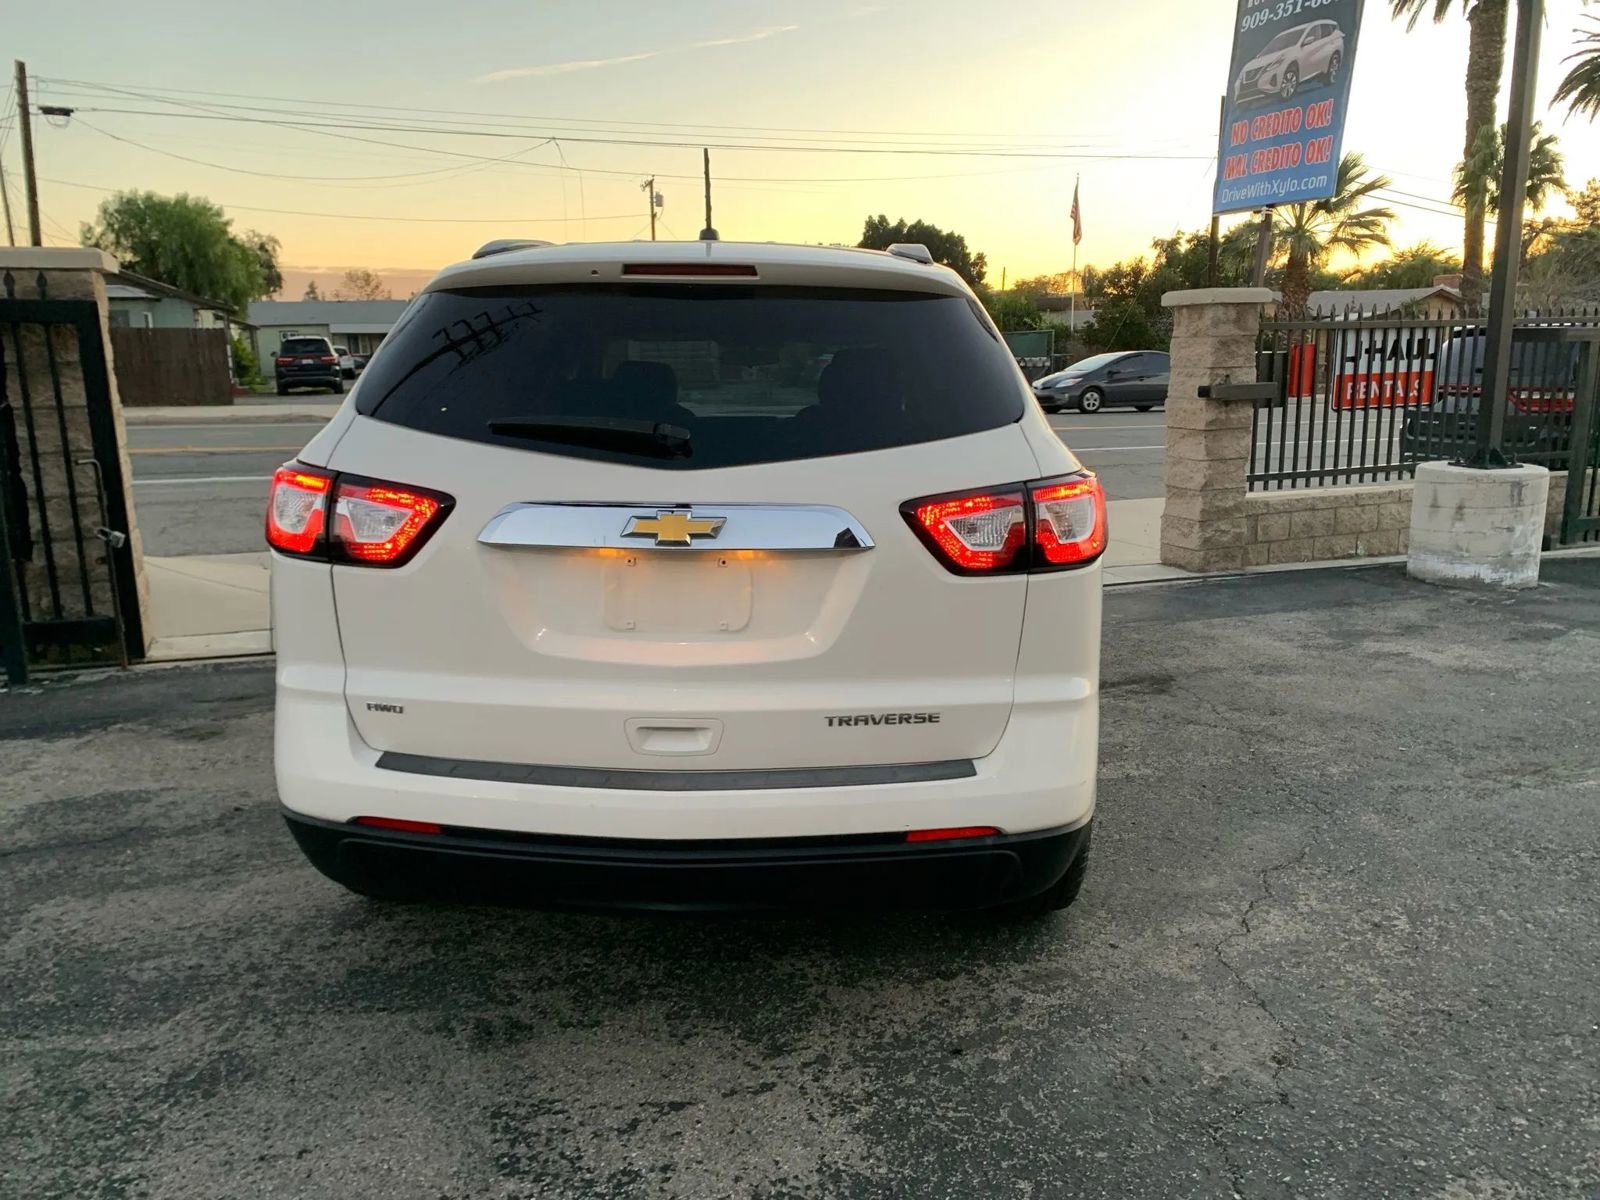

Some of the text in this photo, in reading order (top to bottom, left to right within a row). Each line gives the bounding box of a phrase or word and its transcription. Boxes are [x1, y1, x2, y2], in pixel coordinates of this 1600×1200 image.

[1241, 0, 1341, 32] 909-351-
[1231, 99, 1334, 146] NO CREDITO OK!
[1224, 135, 1334, 180] MAL CREDITO OK!
[1222, 176, 1328, 204] DriveWithXylo.com
[1346, 379, 1425, 400] RENTAS
[824, 712, 941, 727] TRAVERSE
